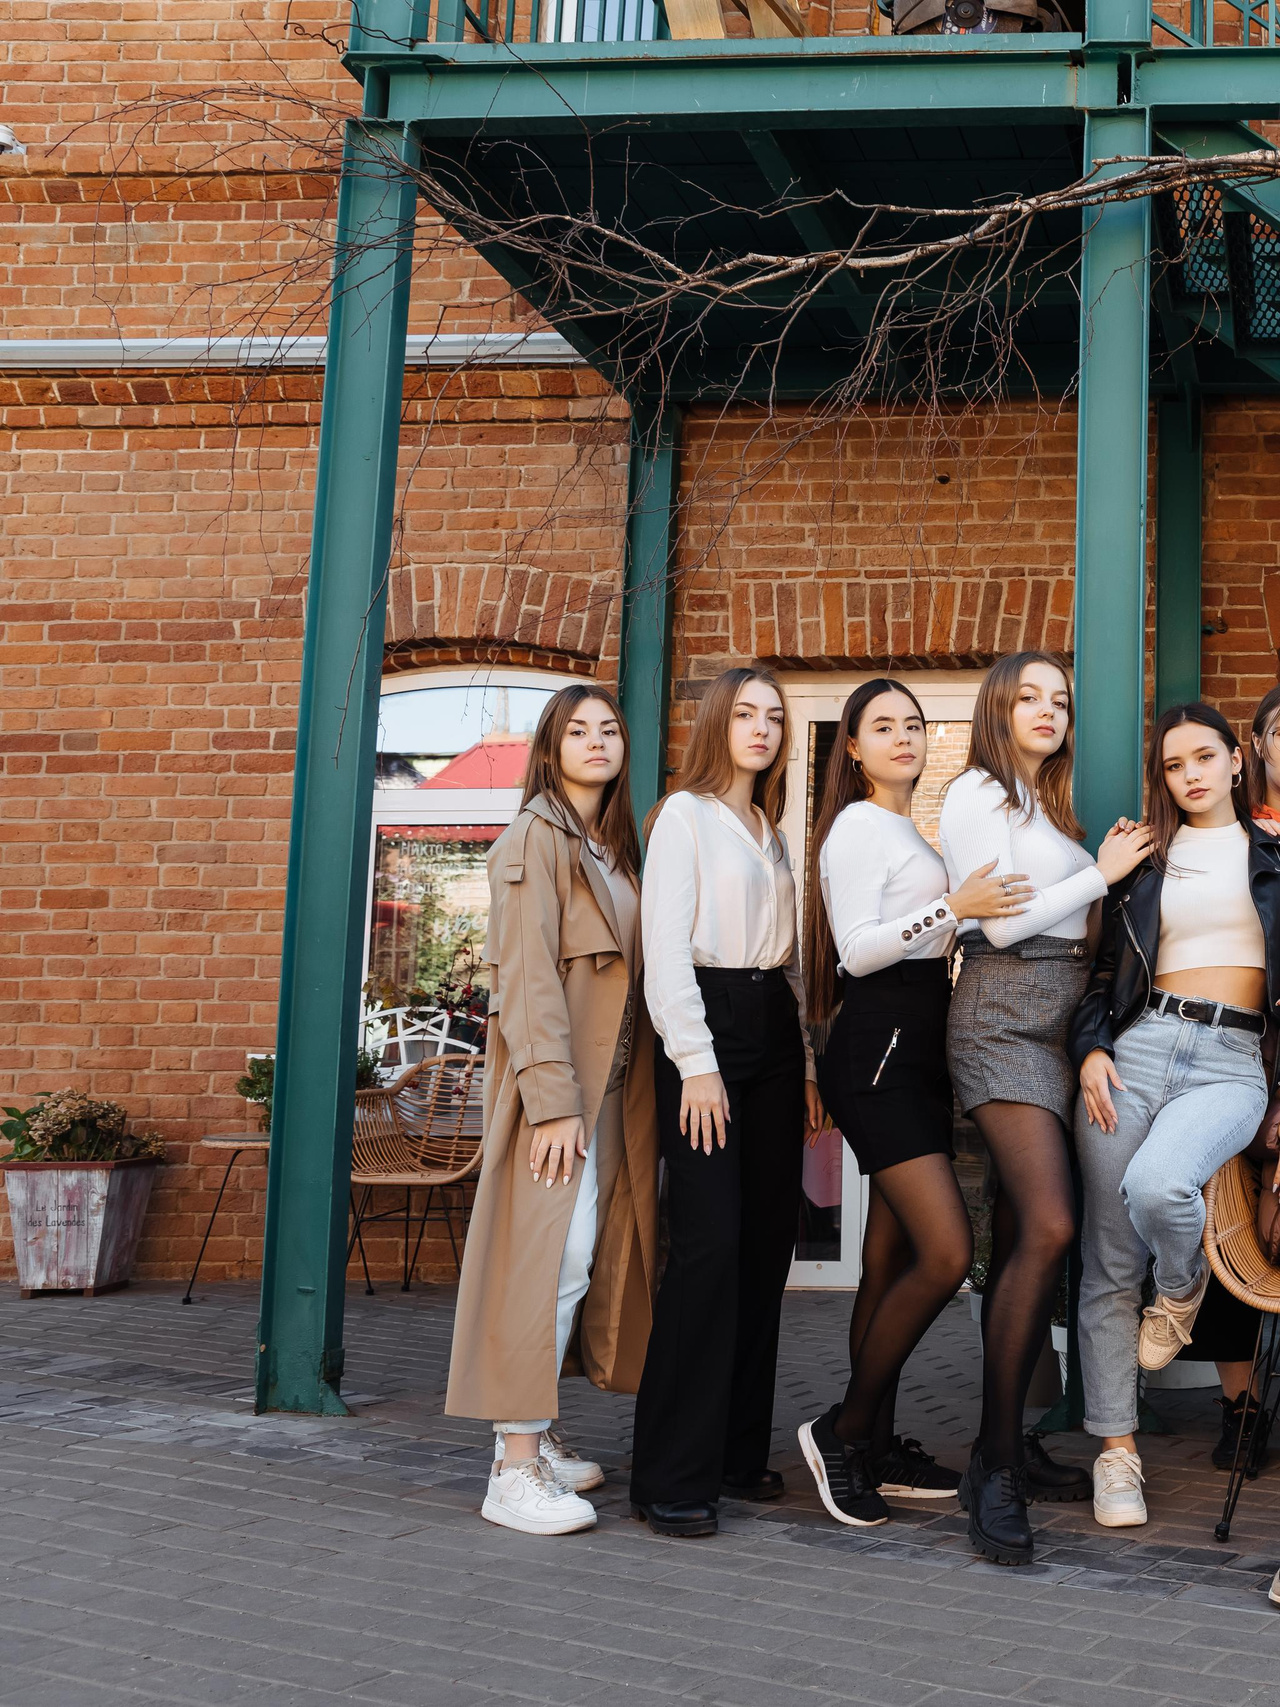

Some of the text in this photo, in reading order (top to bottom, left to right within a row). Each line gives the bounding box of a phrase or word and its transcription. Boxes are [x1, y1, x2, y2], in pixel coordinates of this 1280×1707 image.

[401, 840, 443, 855] Никто
[433, 904, 488, 944] цве
[36, 1200, 47, 1212] Le
[27, 1215, 42, 1227] des
